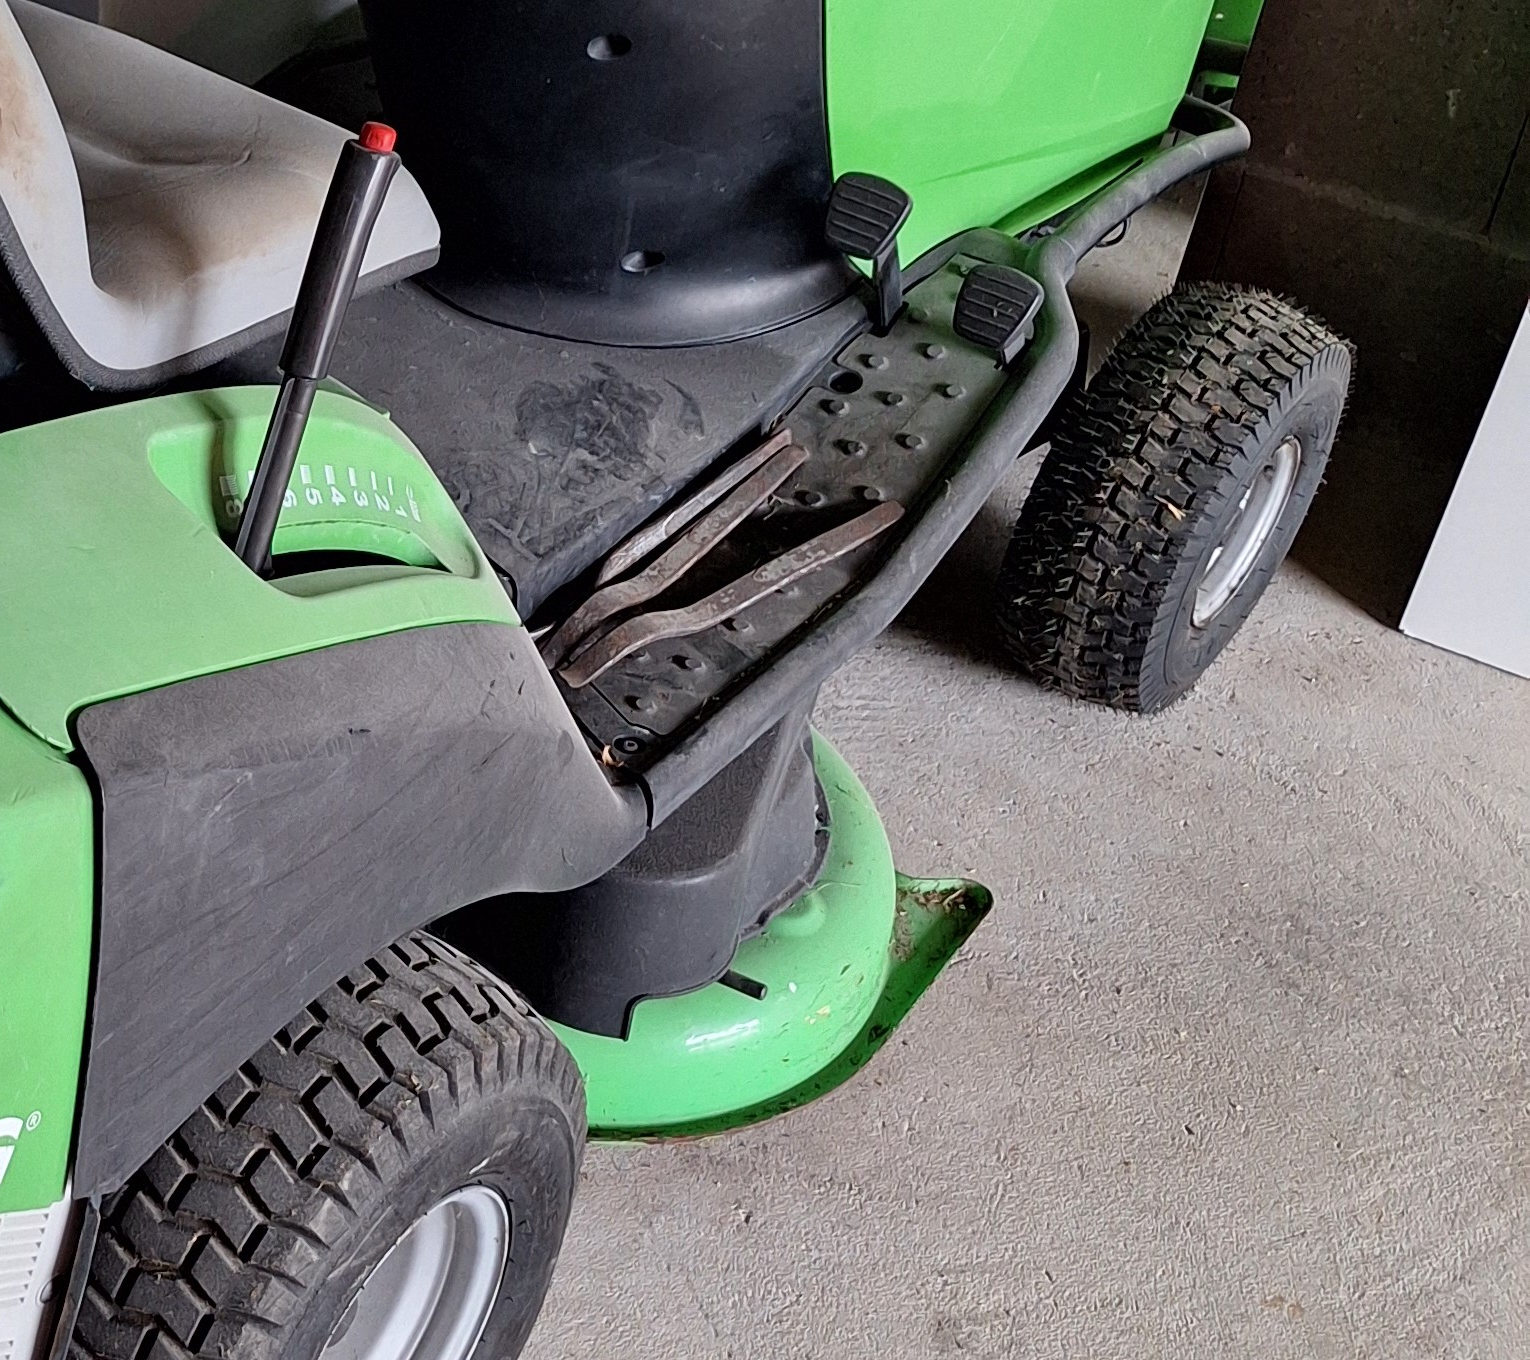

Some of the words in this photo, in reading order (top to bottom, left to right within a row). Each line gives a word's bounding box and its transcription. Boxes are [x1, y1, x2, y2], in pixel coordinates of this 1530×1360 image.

[305, 487, 323, 505] 5
[329, 486, 346, 505] 4
[353, 491, 369, 507] 3
[374, 495, 392, 512] 2
